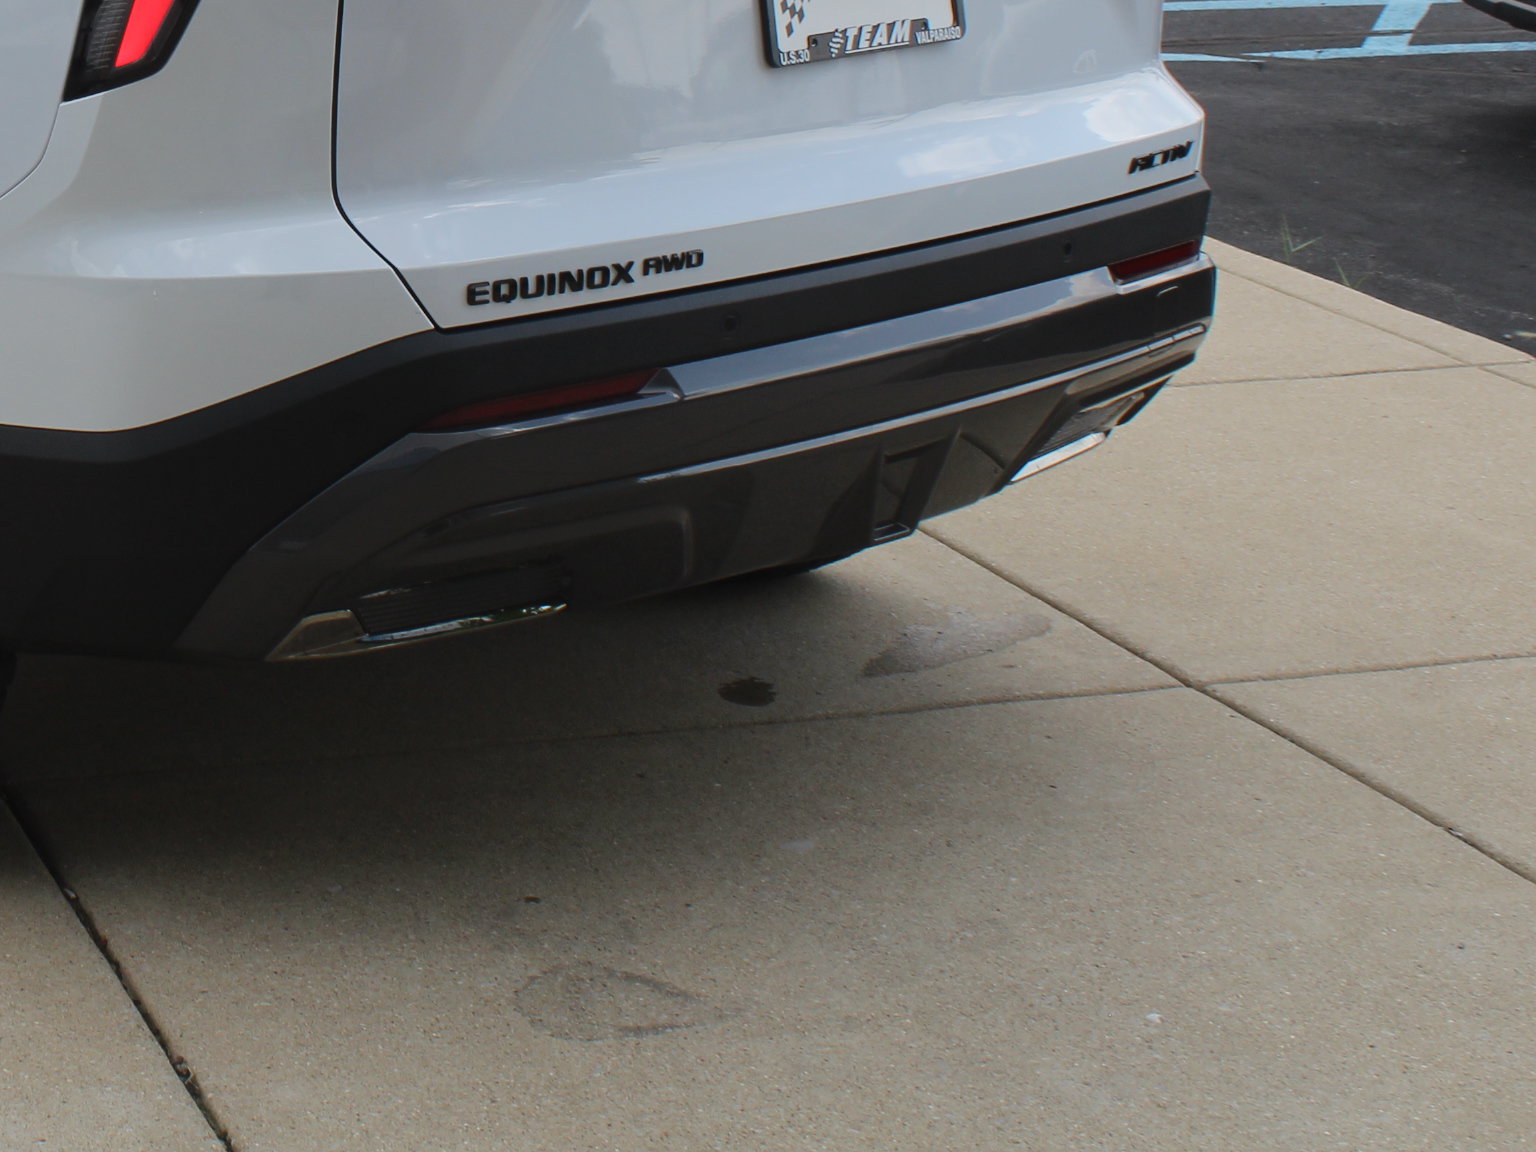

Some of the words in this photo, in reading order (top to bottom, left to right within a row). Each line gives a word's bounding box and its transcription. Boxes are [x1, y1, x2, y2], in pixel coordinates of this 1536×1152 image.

[845, 19, 911, 51] TEAM
[915, 25, 961, 45] VALPARAISO
[466, 261, 635, 306] EQUINOX
[642, 248, 704, 276] AWD
